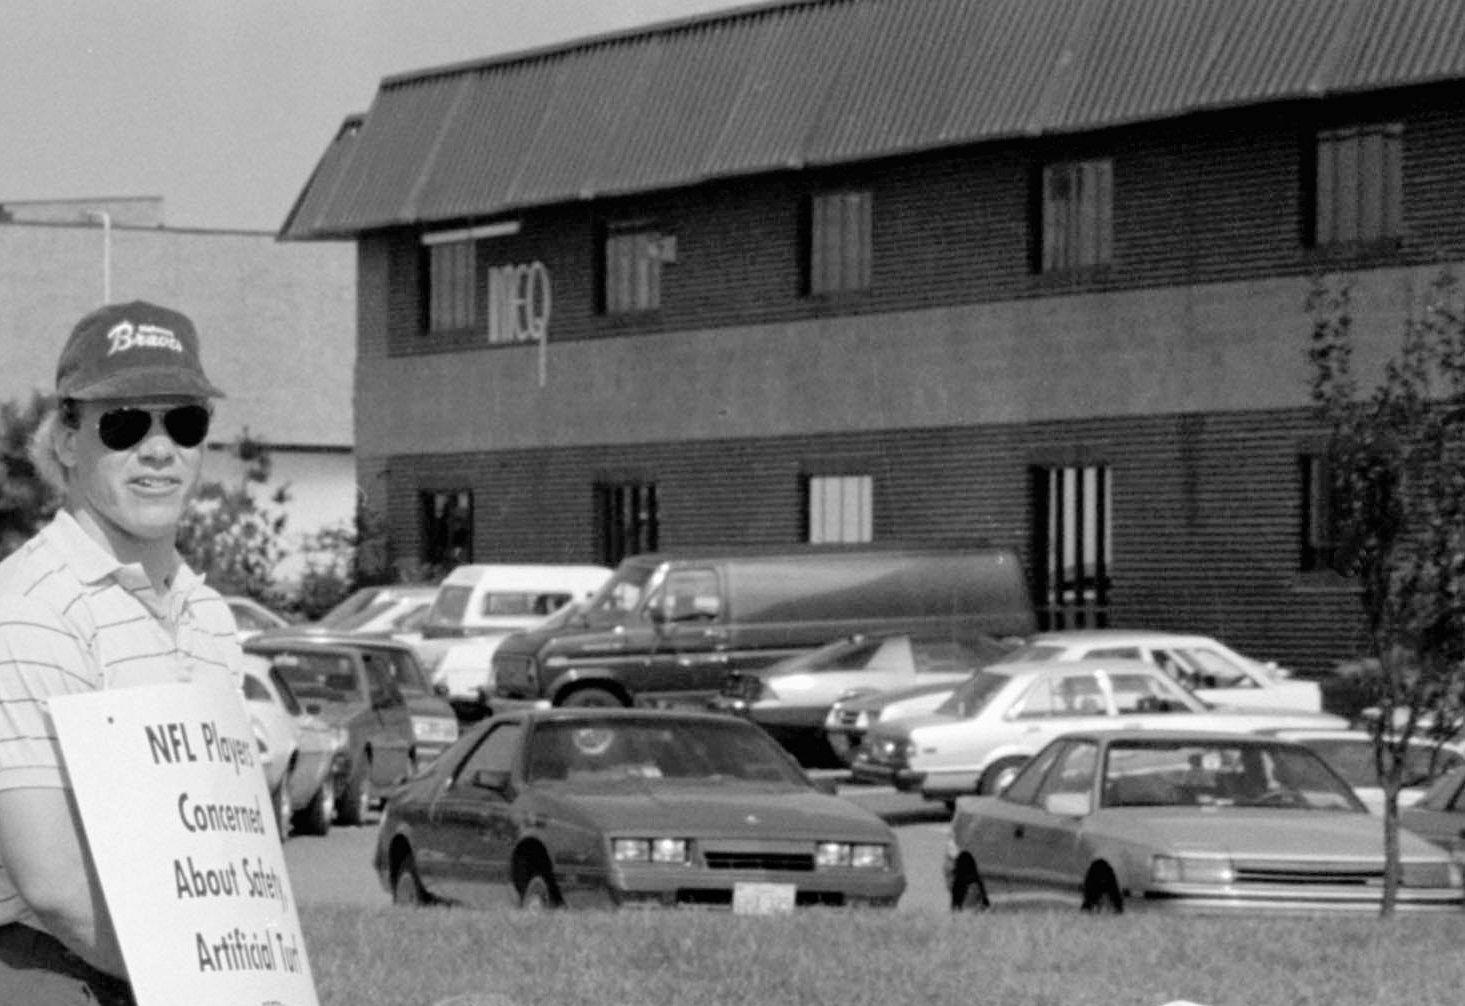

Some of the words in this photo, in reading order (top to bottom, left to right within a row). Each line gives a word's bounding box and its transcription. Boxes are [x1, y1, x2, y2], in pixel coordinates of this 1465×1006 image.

[144, 722, 197, 765] NFL
[178, 792, 265, 835] Concerned
[174, 856, 240, 899] About
[196, 928, 277, 972] Artificial
